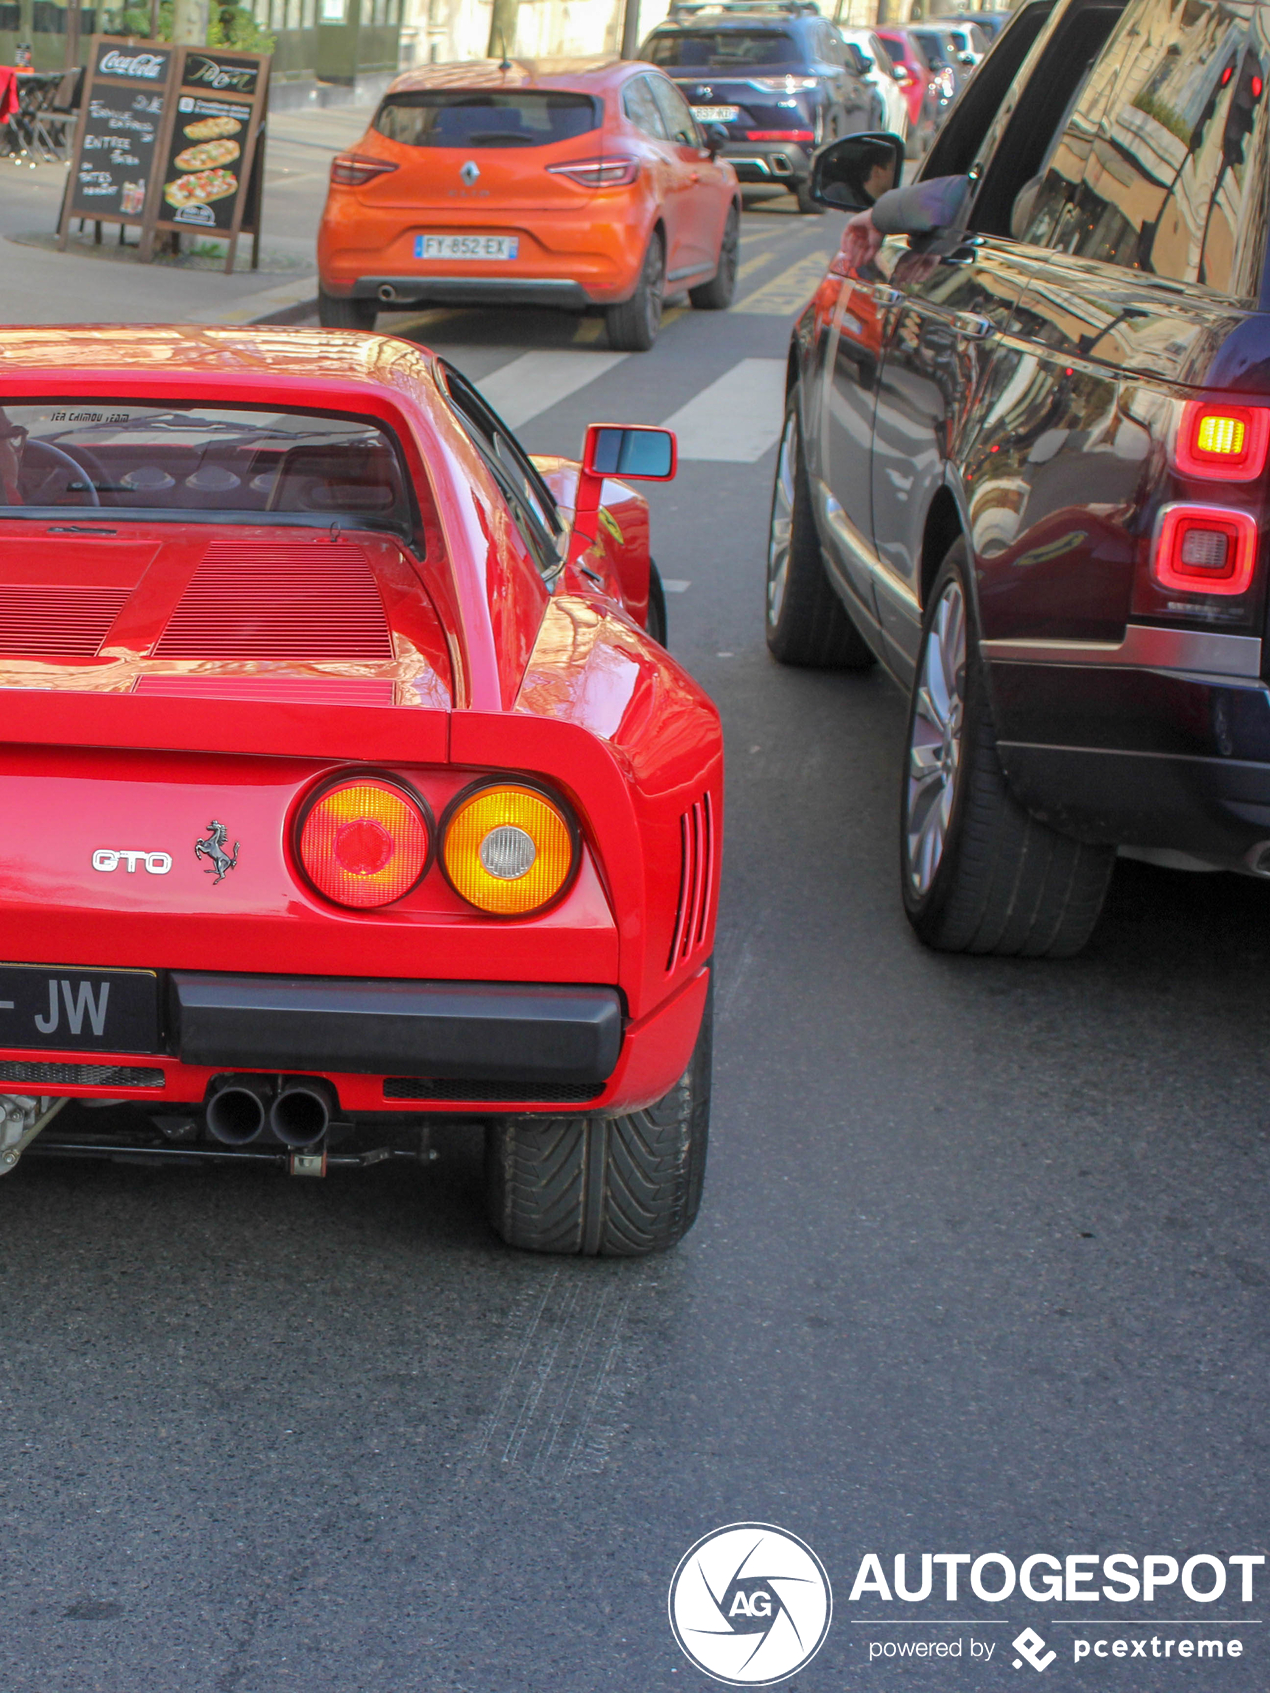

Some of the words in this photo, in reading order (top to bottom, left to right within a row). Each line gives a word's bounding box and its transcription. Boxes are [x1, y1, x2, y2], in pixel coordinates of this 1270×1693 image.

[99, 50, 166, 79] Coca-Cola
[425, 237, 505, 254] FY-852-EX
[92, 849, 172, 874] GTO
[34, 979, 110, 1036] JW
